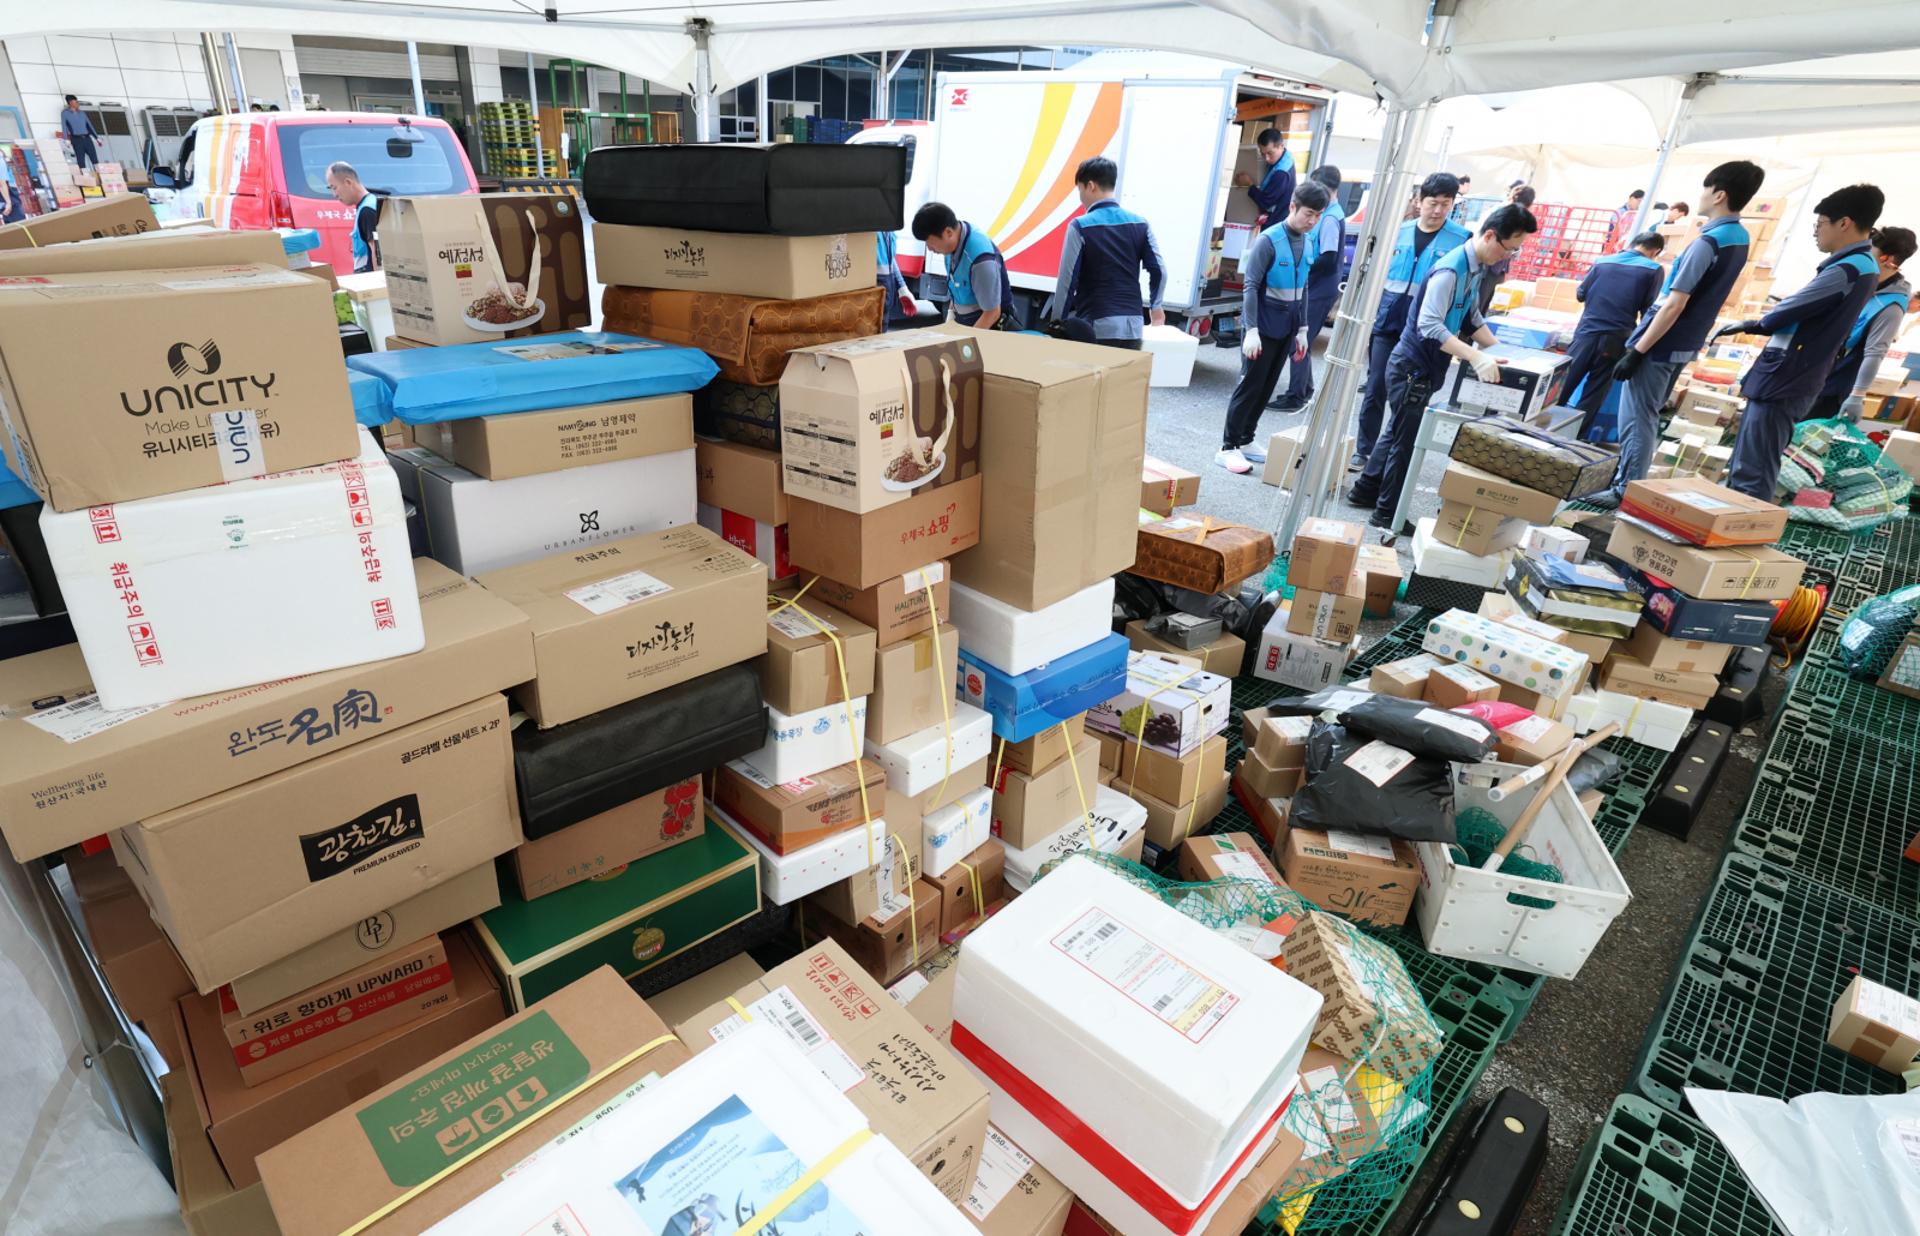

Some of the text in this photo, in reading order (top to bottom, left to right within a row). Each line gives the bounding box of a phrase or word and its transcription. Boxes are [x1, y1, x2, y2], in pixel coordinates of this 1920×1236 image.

[438, 246, 485, 265] 예정성
[120, 373, 276, 417] UNICITY
[145, 418, 190, 436] Make
[868, 403, 905, 426] 예정성
[357, 531, 383, 584] 취급주의
[543, 525, 638, 552] URBANFLOWER
[575, 547, 622, 564] 취급주의
[110, 561, 145, 620] 취급주의
[400, 738, 441, 766] 골드라벨
[442, 724, 481, 750] 선물세트
[31, 770, 106, 801] Wellbeing life
[318, 806, 409, 864] 광천김
[353, 841, 422, 876] PREMIUM SEAWEED
[254, 956, 425, 1037] 위로 향하게 UPWARD
[389, 1038, 557, 1144] 생달걀 깨짐 주의
